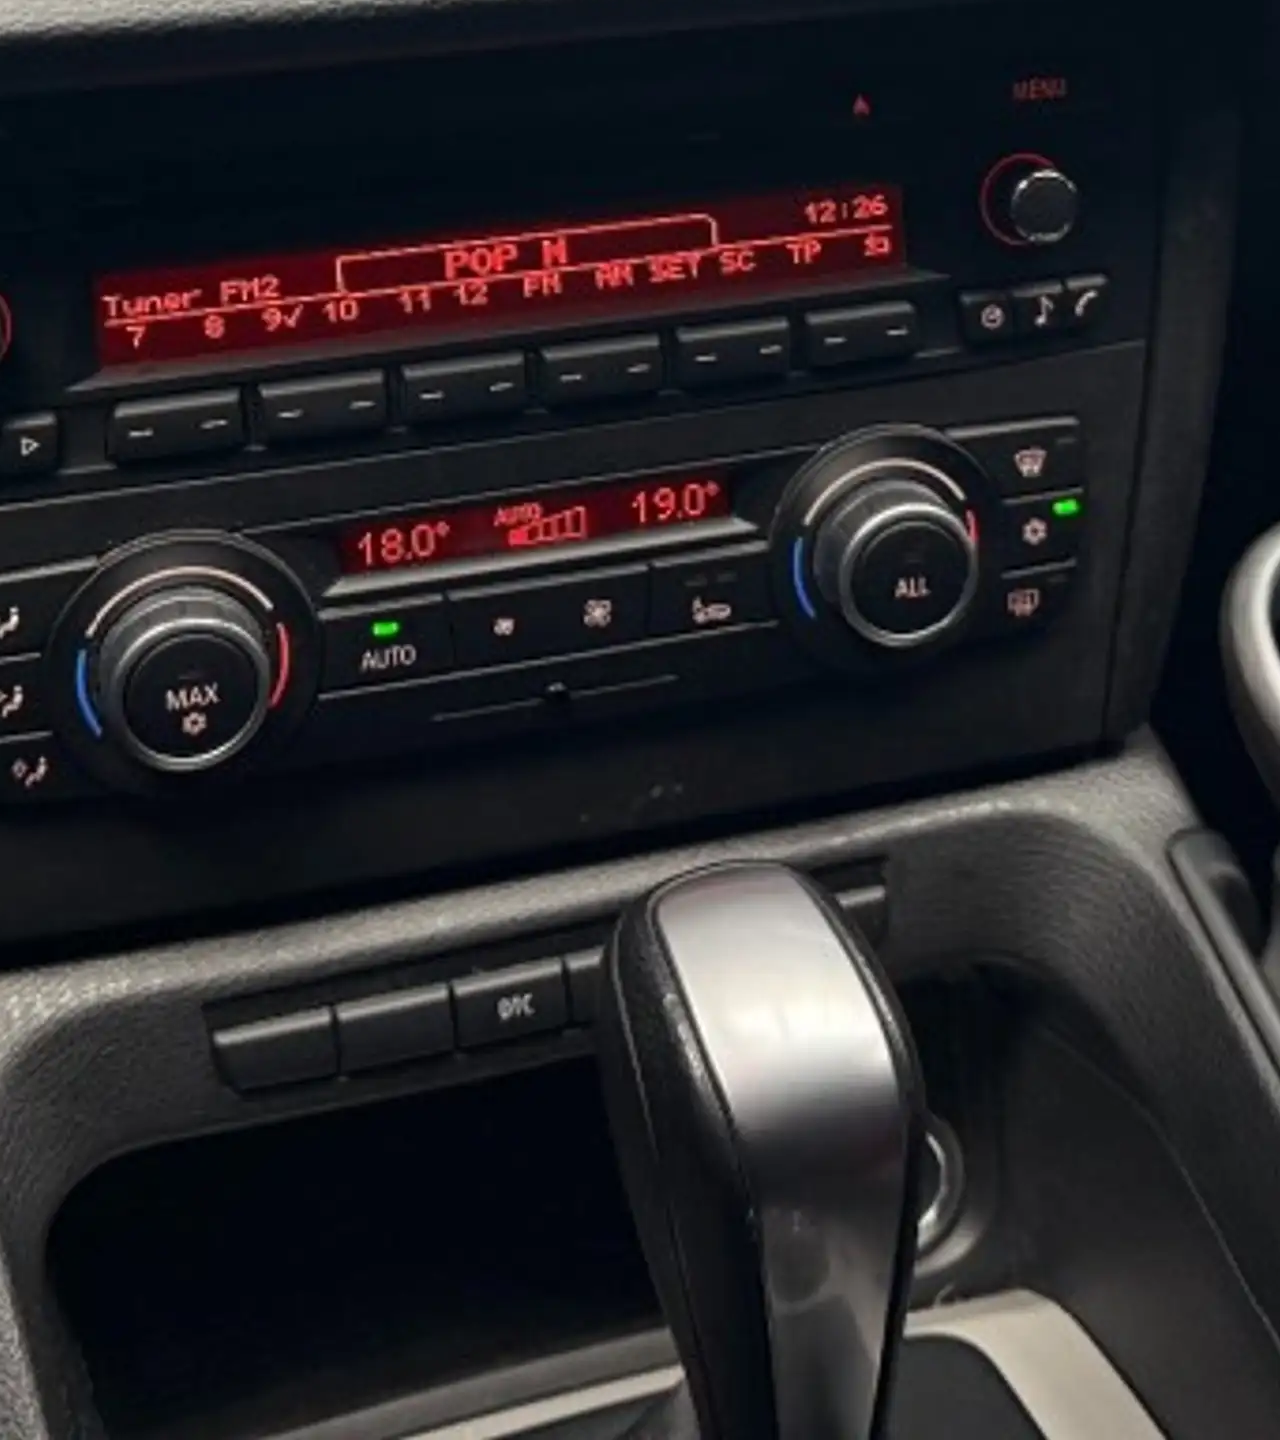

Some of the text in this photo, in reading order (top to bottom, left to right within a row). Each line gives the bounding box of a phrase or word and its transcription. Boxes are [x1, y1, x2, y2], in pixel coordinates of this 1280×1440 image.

[323, 297, 359, 323] 10
[719, 251, 756, 274] SC
[786, 239, 822, 264] TP
[444, 243, 518, 281] POP
[102, 273, 281, 318] Tuner FM2
[361, 644, 417, 672] AUTO
[165, 682, 219, 712] MAX
